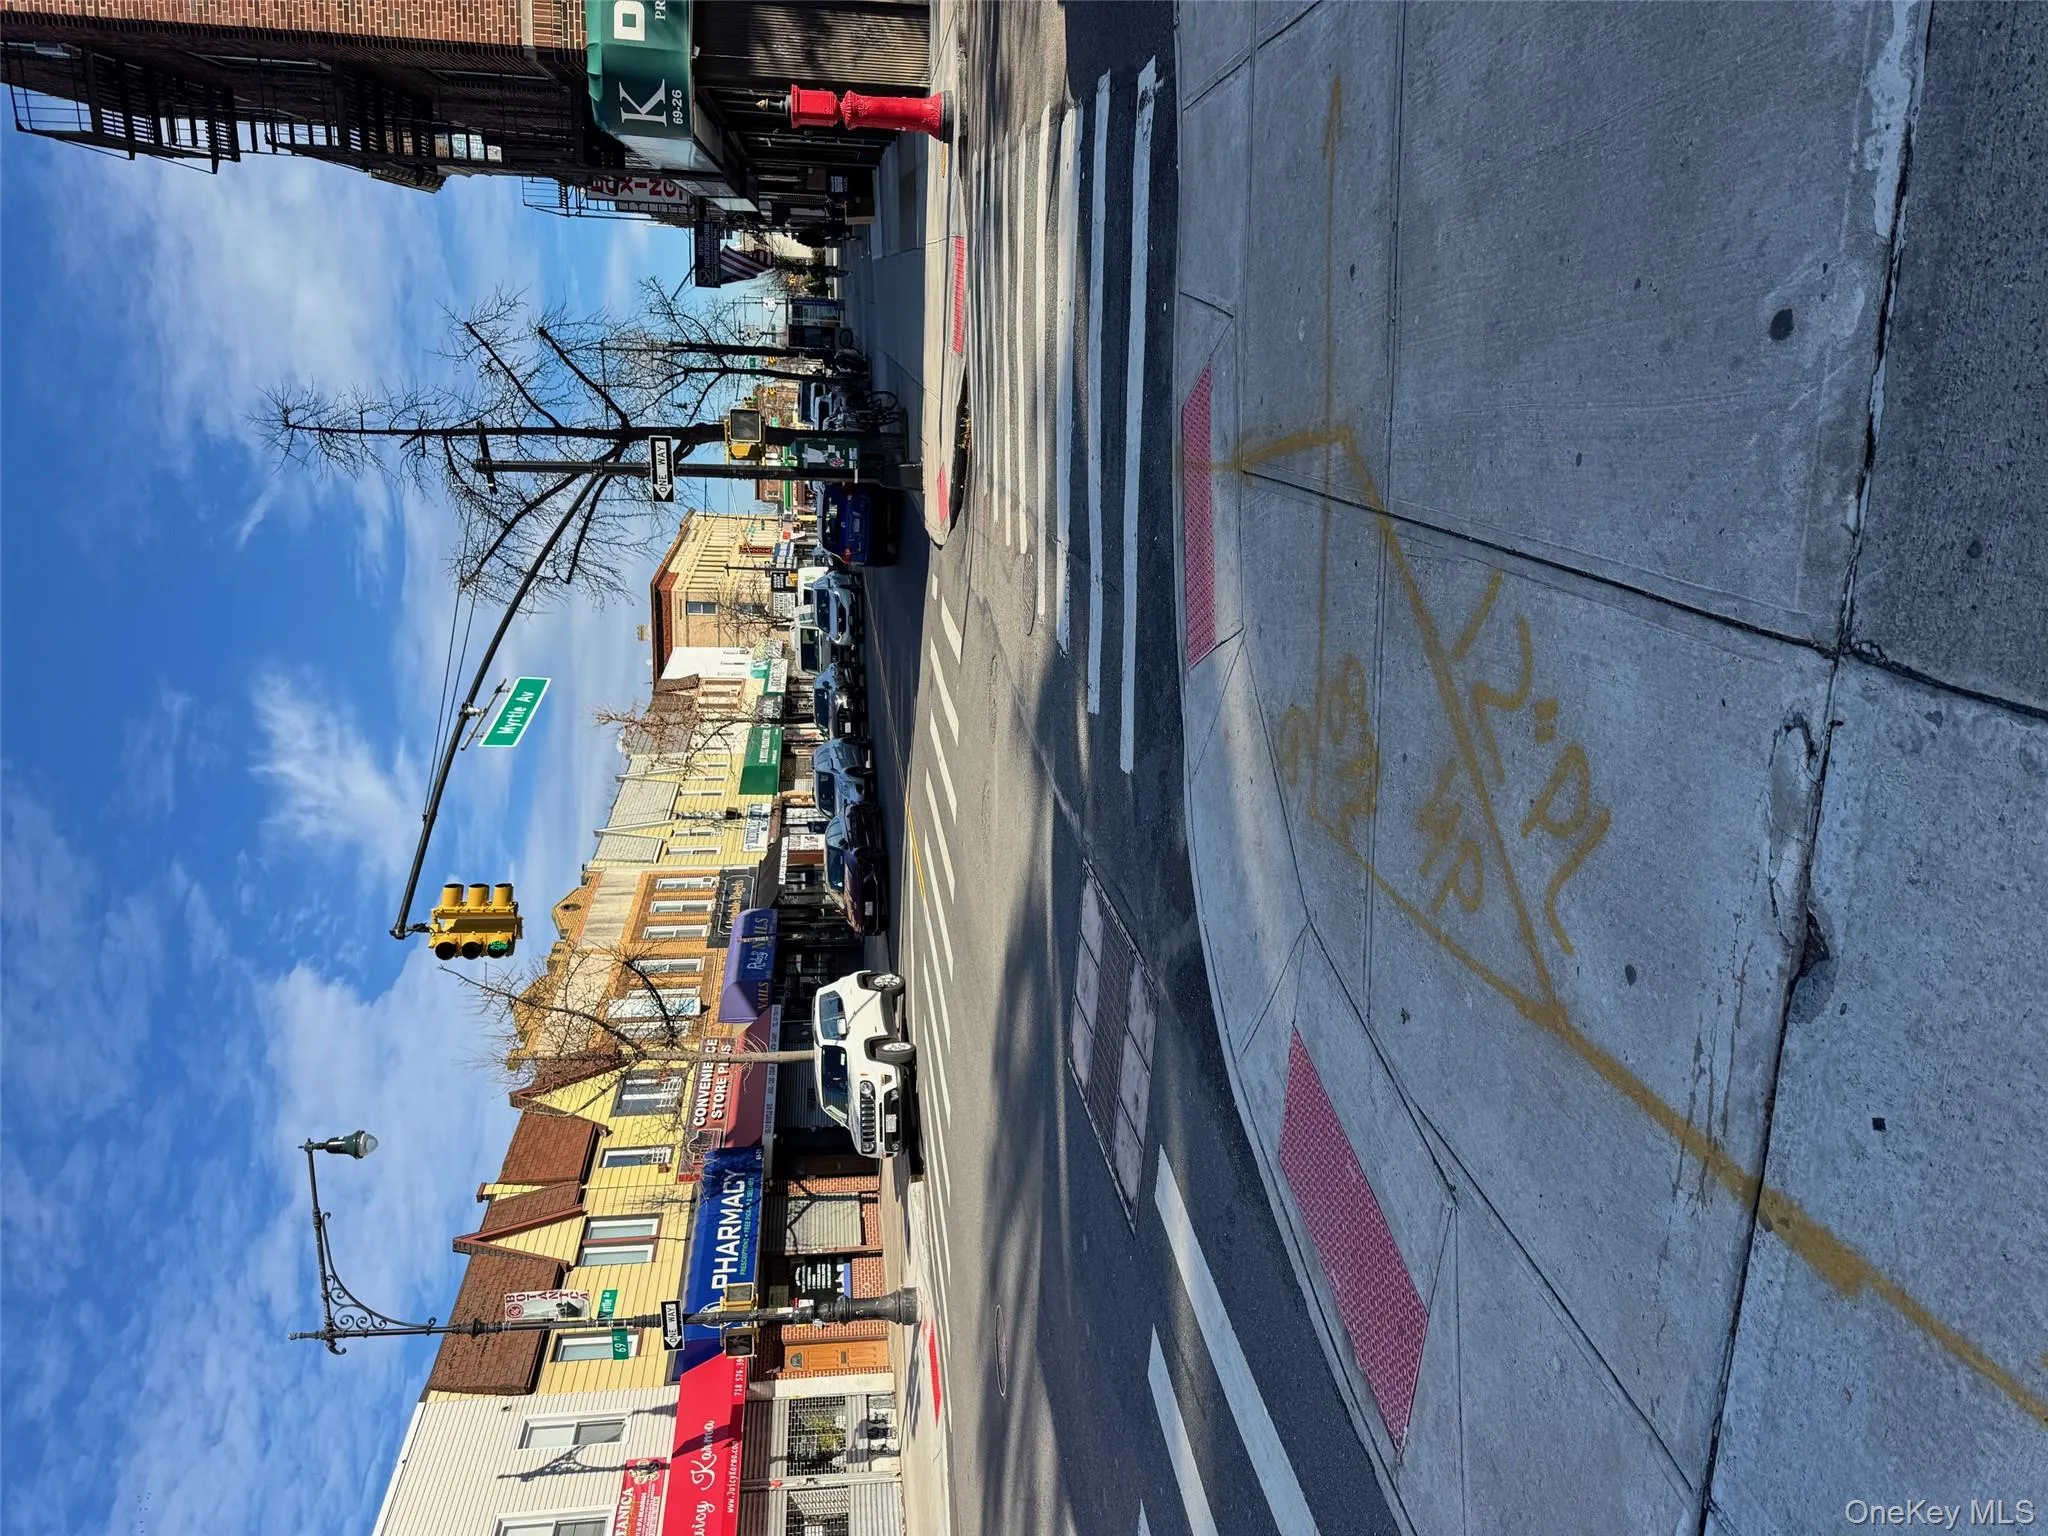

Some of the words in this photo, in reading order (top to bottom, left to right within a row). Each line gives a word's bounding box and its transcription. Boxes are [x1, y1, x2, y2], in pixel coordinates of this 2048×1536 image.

[618, 78, 668, 127] K
[671, 89, 683, 124] 69-26
[657, 445, 666, 466] WAY
[658, 474, 668, 493] ONE
[496, 706, 527, 734] Myrtle
[515, 691, 535, 703] Av
[757, 982, 769, 1009] NAILS
[693, 1039, 718, 1126] CONVENIECE
[711, 1077, 727, 1118] STORE
[711, 1168, 746, 1289] PHARMACY
[505, 1290, 589, 1304] BOTANICA
[666, 1306, 676, 1323] WAY
[614, 1343, 626, 1352] 69
[668, 1328, 678, 1343] ONE
[690, 1420, 717, 1490] Karma
